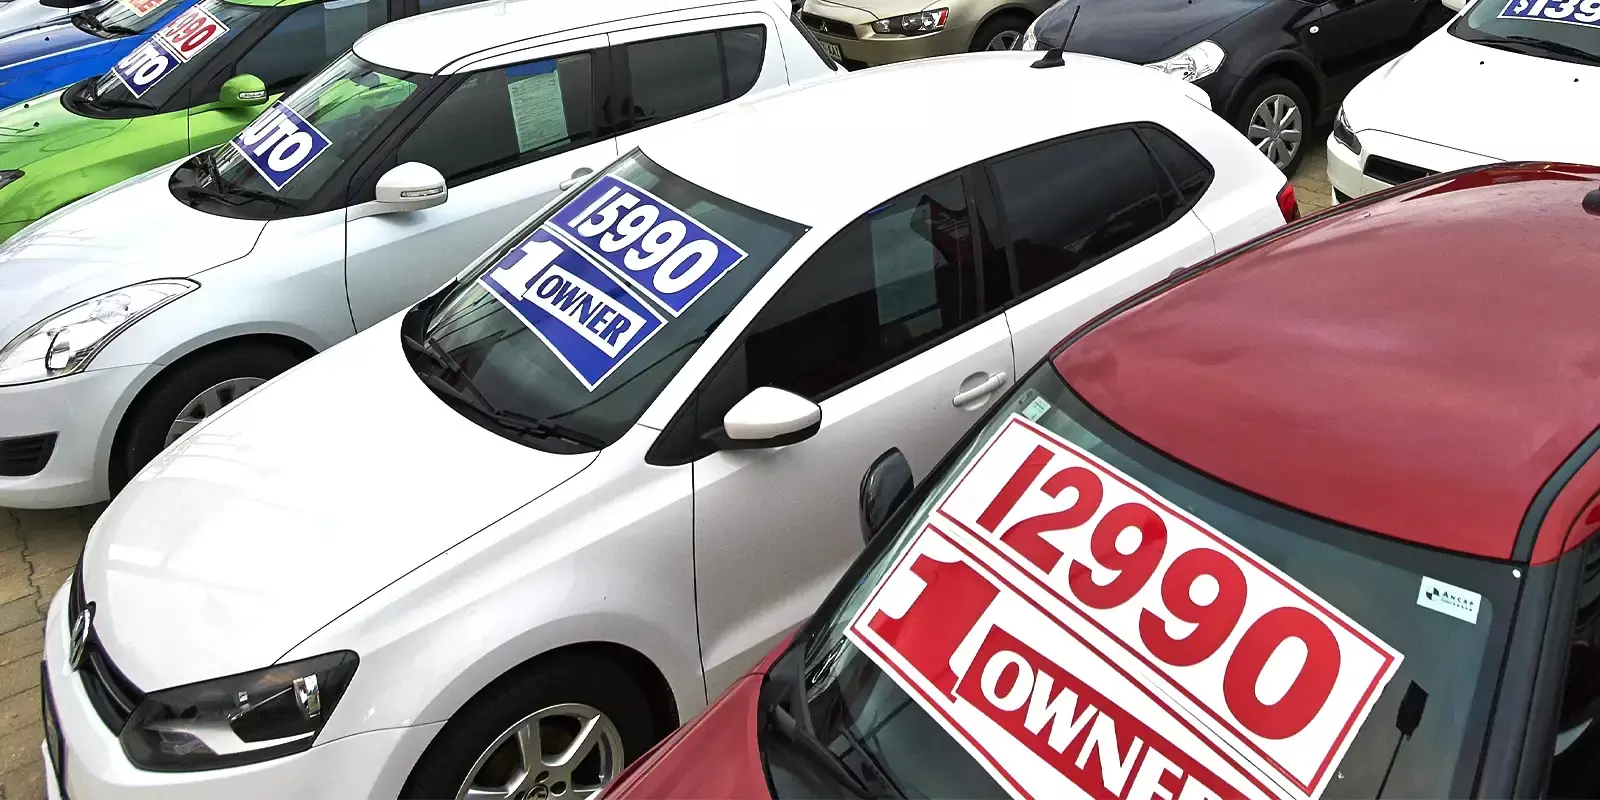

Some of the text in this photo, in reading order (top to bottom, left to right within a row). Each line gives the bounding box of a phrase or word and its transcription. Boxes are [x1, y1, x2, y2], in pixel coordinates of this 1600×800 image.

[166, 11, 217, 53] 990
[239, 107, 313, 172] UTO
[489, 240, 632, 347] 1 OWNER
[567, 186, 719, 294] 15990
[868, 552, 1001, 704] 1
[976, 445, 1341, 740] 12990
